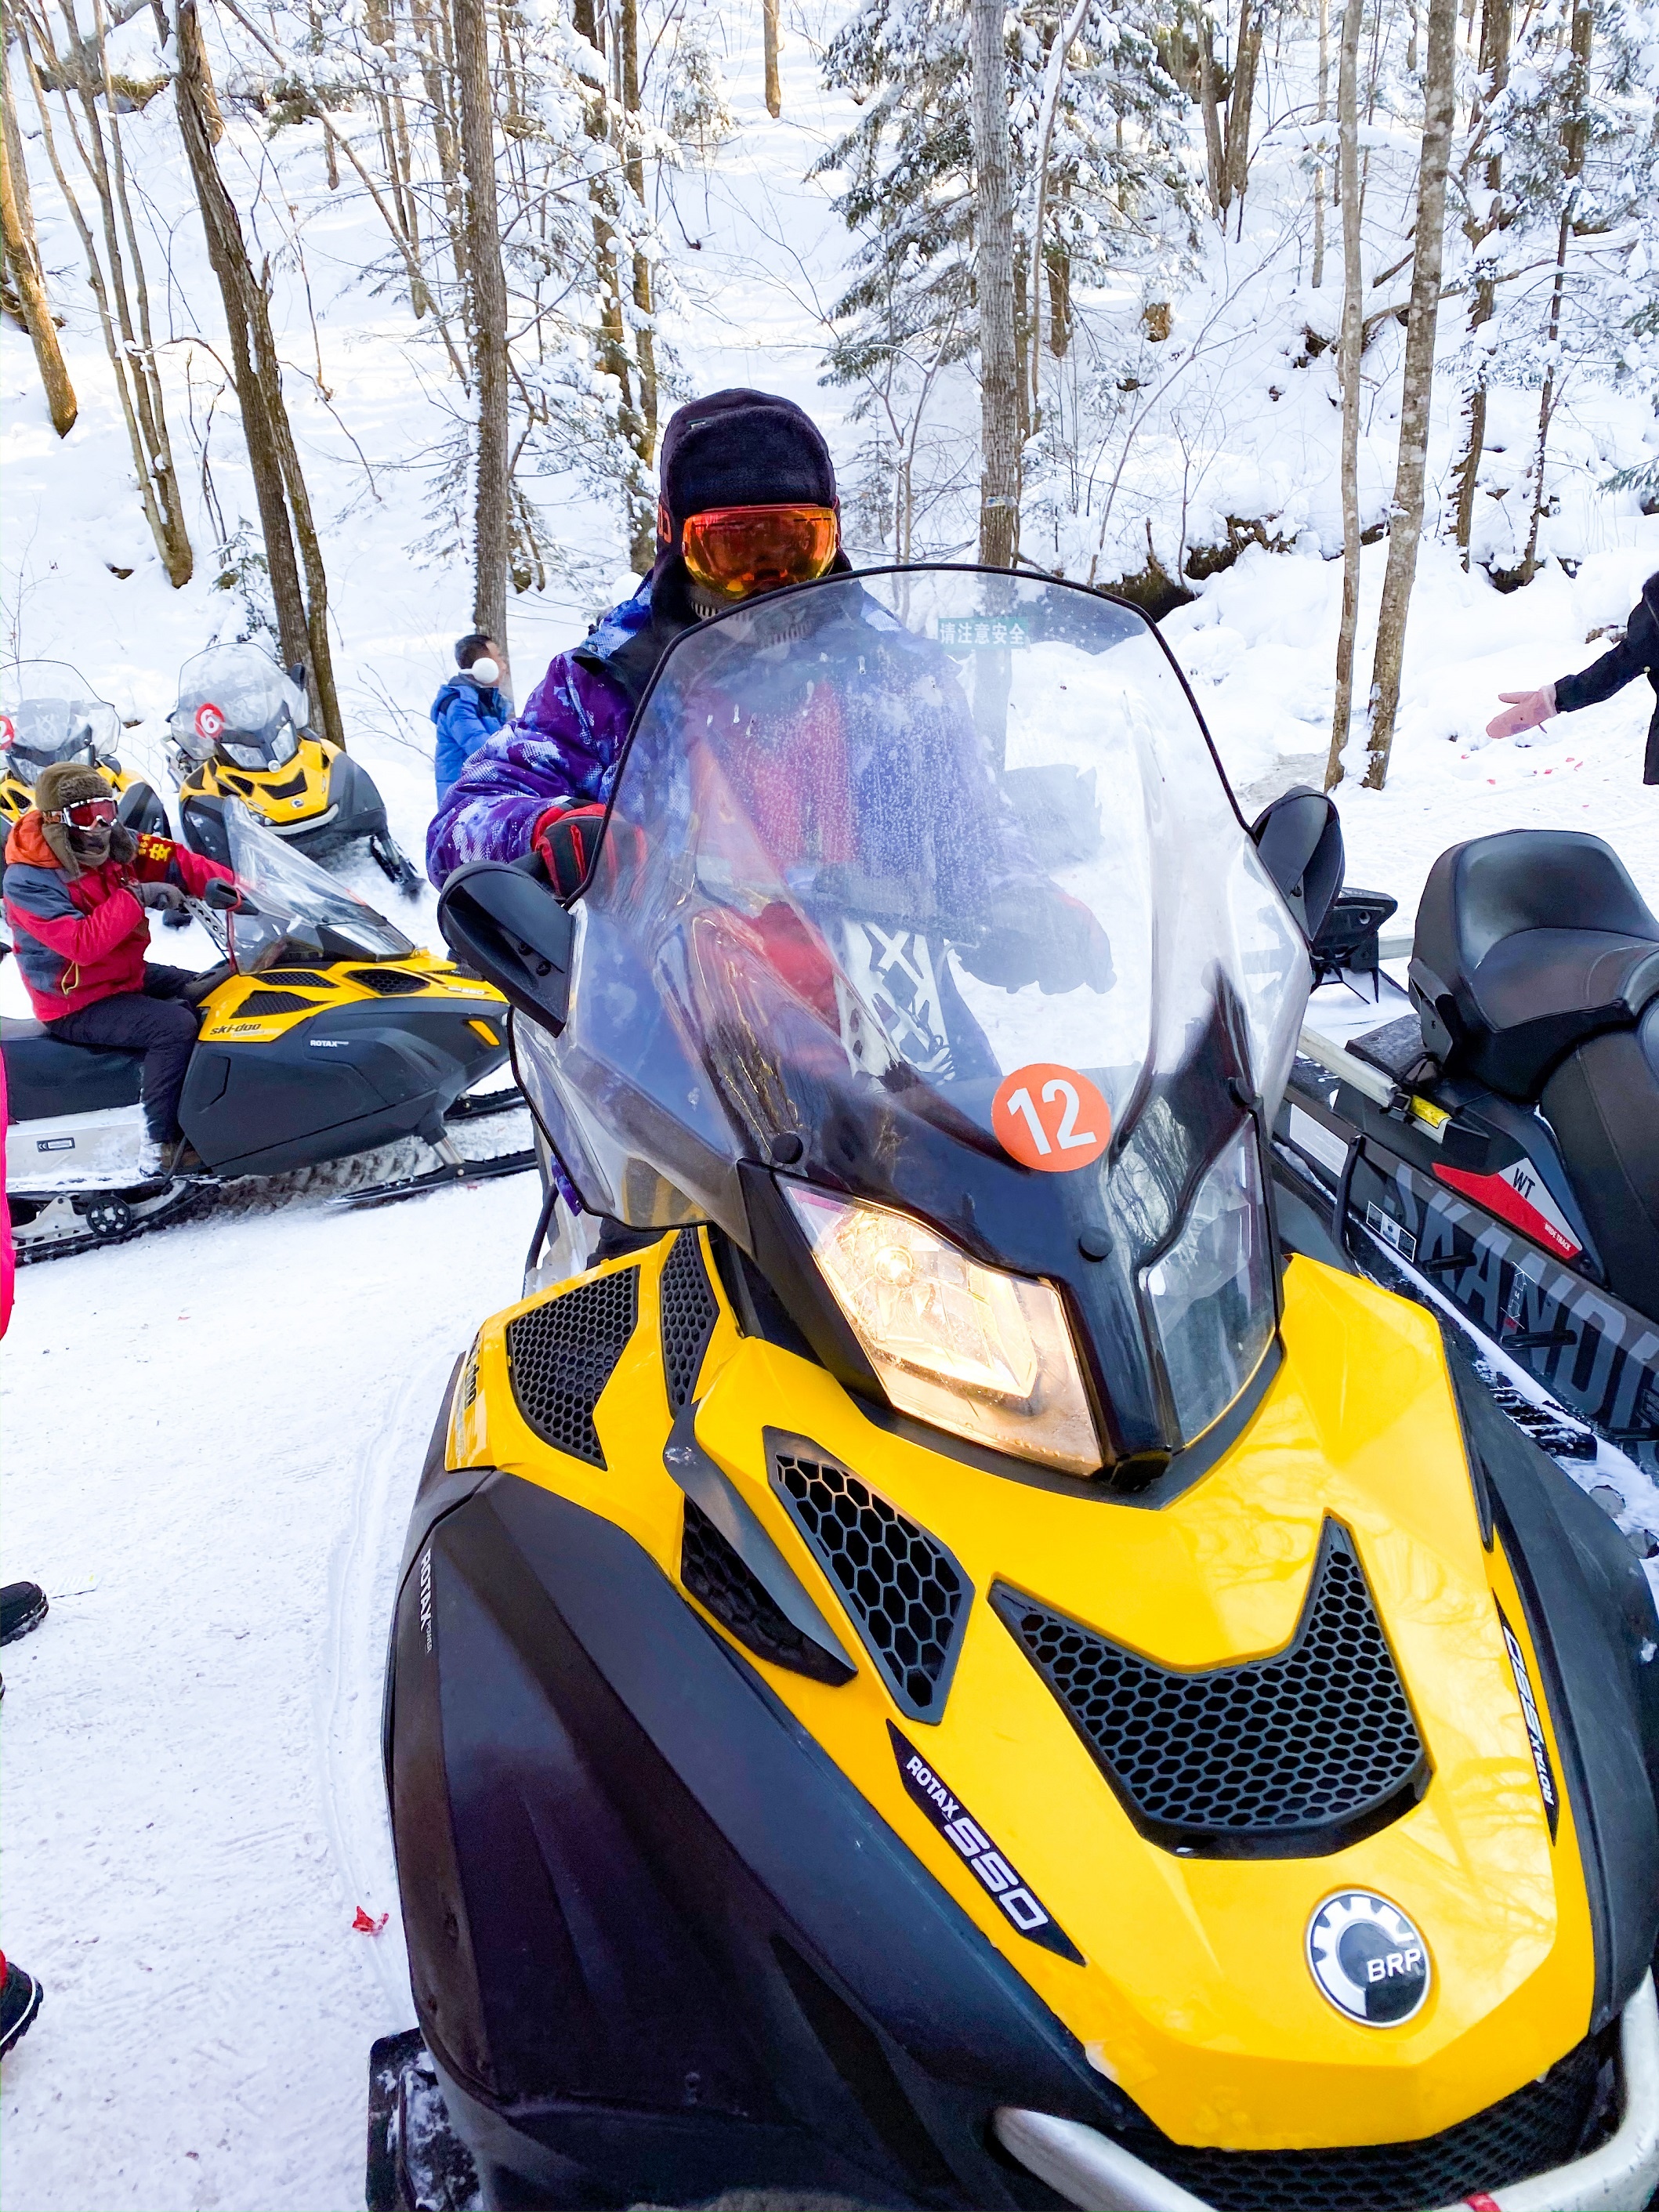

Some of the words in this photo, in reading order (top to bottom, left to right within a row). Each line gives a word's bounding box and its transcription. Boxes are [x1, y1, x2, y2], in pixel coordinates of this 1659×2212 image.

[940, 622, 1025, 644] 请注意安全
[200, 708, 220, 734] 6
[310, 1039, 338, 1048] ROTAX
[1006, 1078, 1098, 1156] 12
[1512, 1167, 1536, 1200] WT
[1544, 1222, 1558, 1238] WIDE
[1555, 1234, 1571, 1251] TRACK
[1384, 1162, 1659, 1465] SKANDI
[420, 1548, 432, 1632] ROTAX
[1503, 1624, 1545, 1745] 550
[1530, 1733, 1555, 1805] ROTAX
[906, 1755, 960, 1819] ROTAX
[944, 1816, 1049, 1931] 550
[1366, 1947, 1422, 1984] BRP
